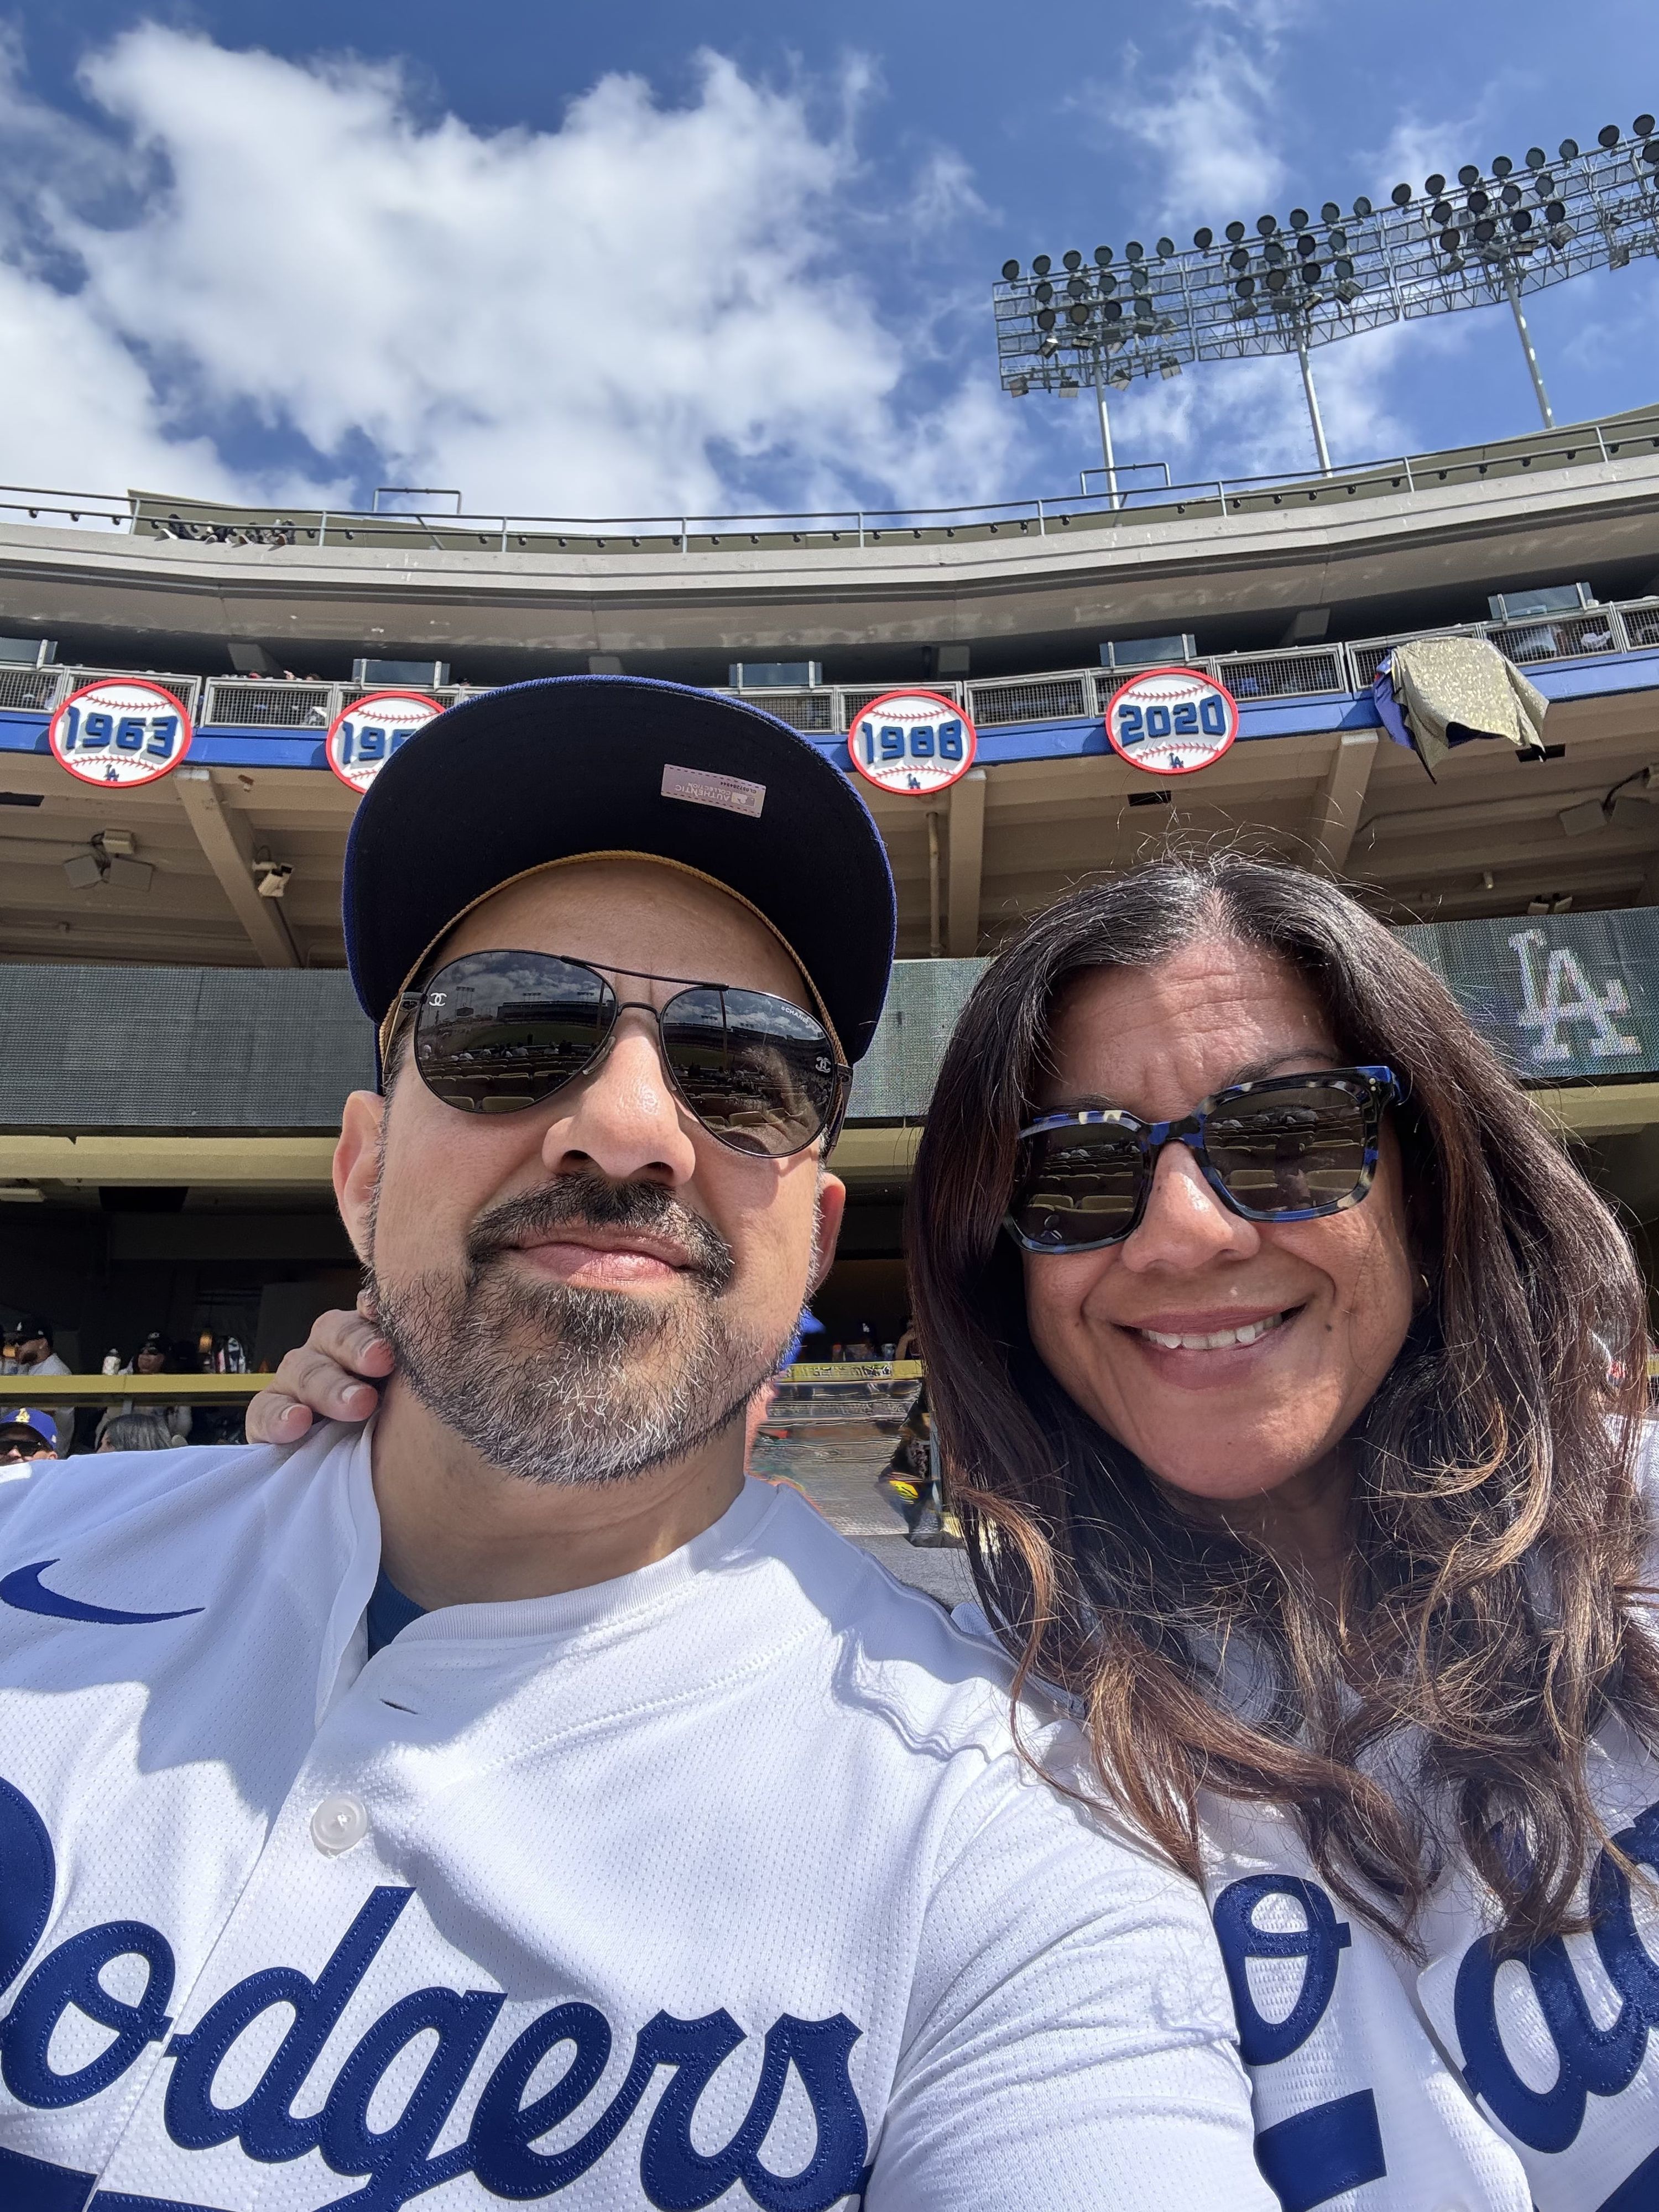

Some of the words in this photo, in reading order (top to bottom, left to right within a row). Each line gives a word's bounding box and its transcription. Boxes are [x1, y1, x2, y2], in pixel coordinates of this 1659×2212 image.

[66, 705, 179, 759] 1963
[342, 720, 417, 765] 19
[862, 719, 963, 764] 1988
[1118, 694, 1227, 747] 2020
[1167, 752, 1185, 768] LA
[675, 784, 731, 801] AUTHENTIC
[688, 782, 731, 796] COLLECTION
[1507, 928, 1642, 1063] LA
